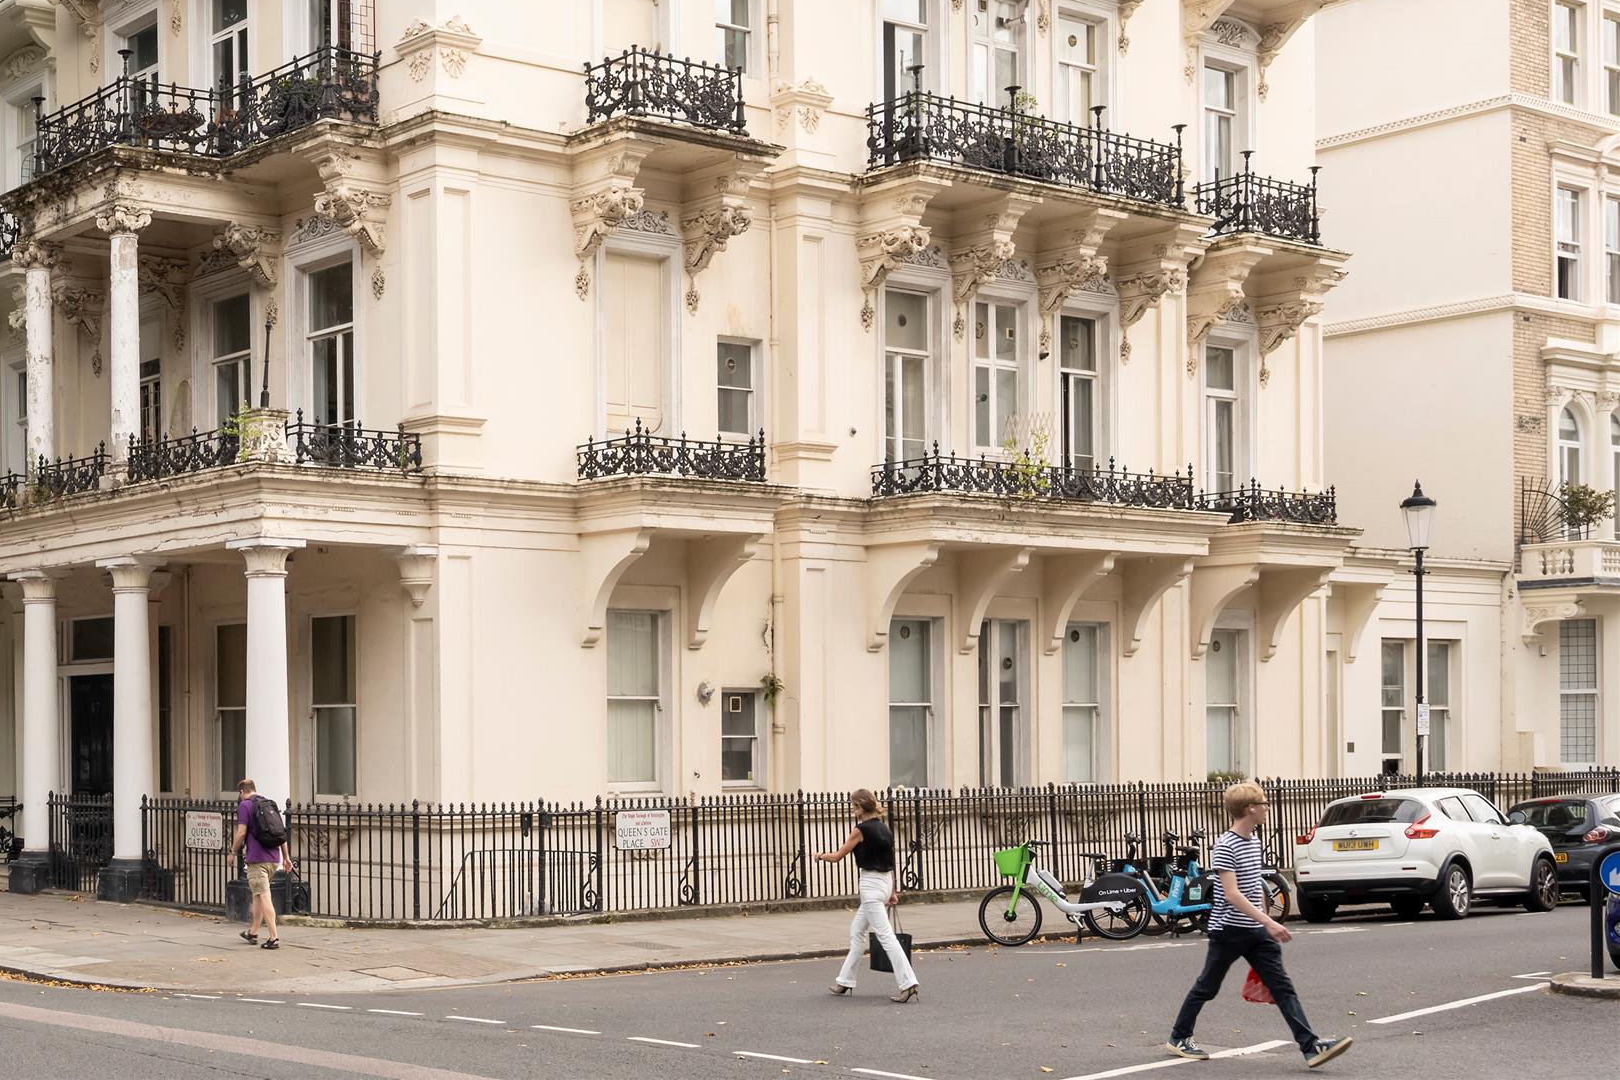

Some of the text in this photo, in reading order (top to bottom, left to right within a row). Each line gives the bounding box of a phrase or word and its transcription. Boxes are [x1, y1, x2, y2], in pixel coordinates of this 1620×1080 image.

[649, 826, 668, 837] GATE
[187, 837, 205, 847] GATE
[622, 839, 644, 848] PLACE
